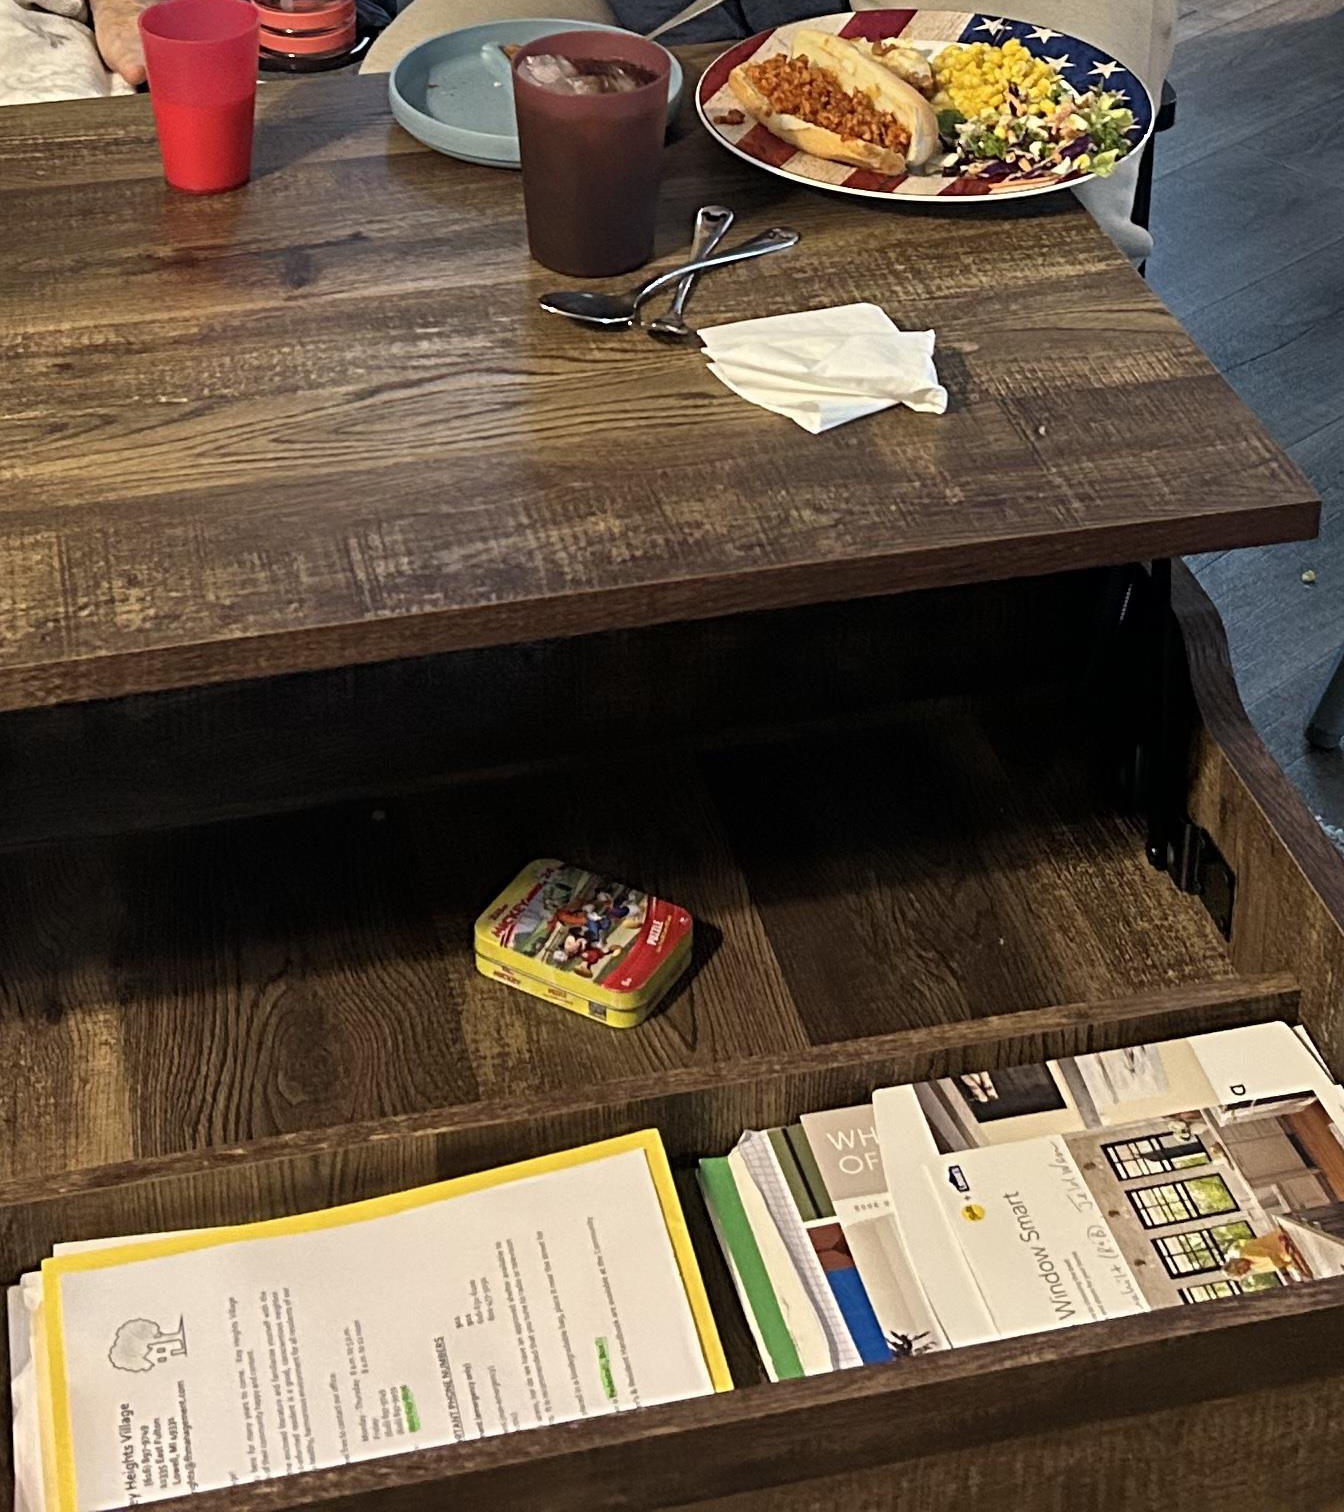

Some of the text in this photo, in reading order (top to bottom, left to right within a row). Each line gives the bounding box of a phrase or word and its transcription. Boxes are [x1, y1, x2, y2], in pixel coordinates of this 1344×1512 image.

[826, 1127, 880, 1152] WH
[1003, 1190, 1077, 1321] Window Smart
[434, 1336, 464, 1441] RTANT PHONE NUMBERS
[119, 1403, 134, 1443] Village
[153, 1418, 162, 1444] Fulton
[155, 1446, 164, 1464] East
[169, 1442, 176, 1453] MI
[122, 1445, 138, 1490] Heights
